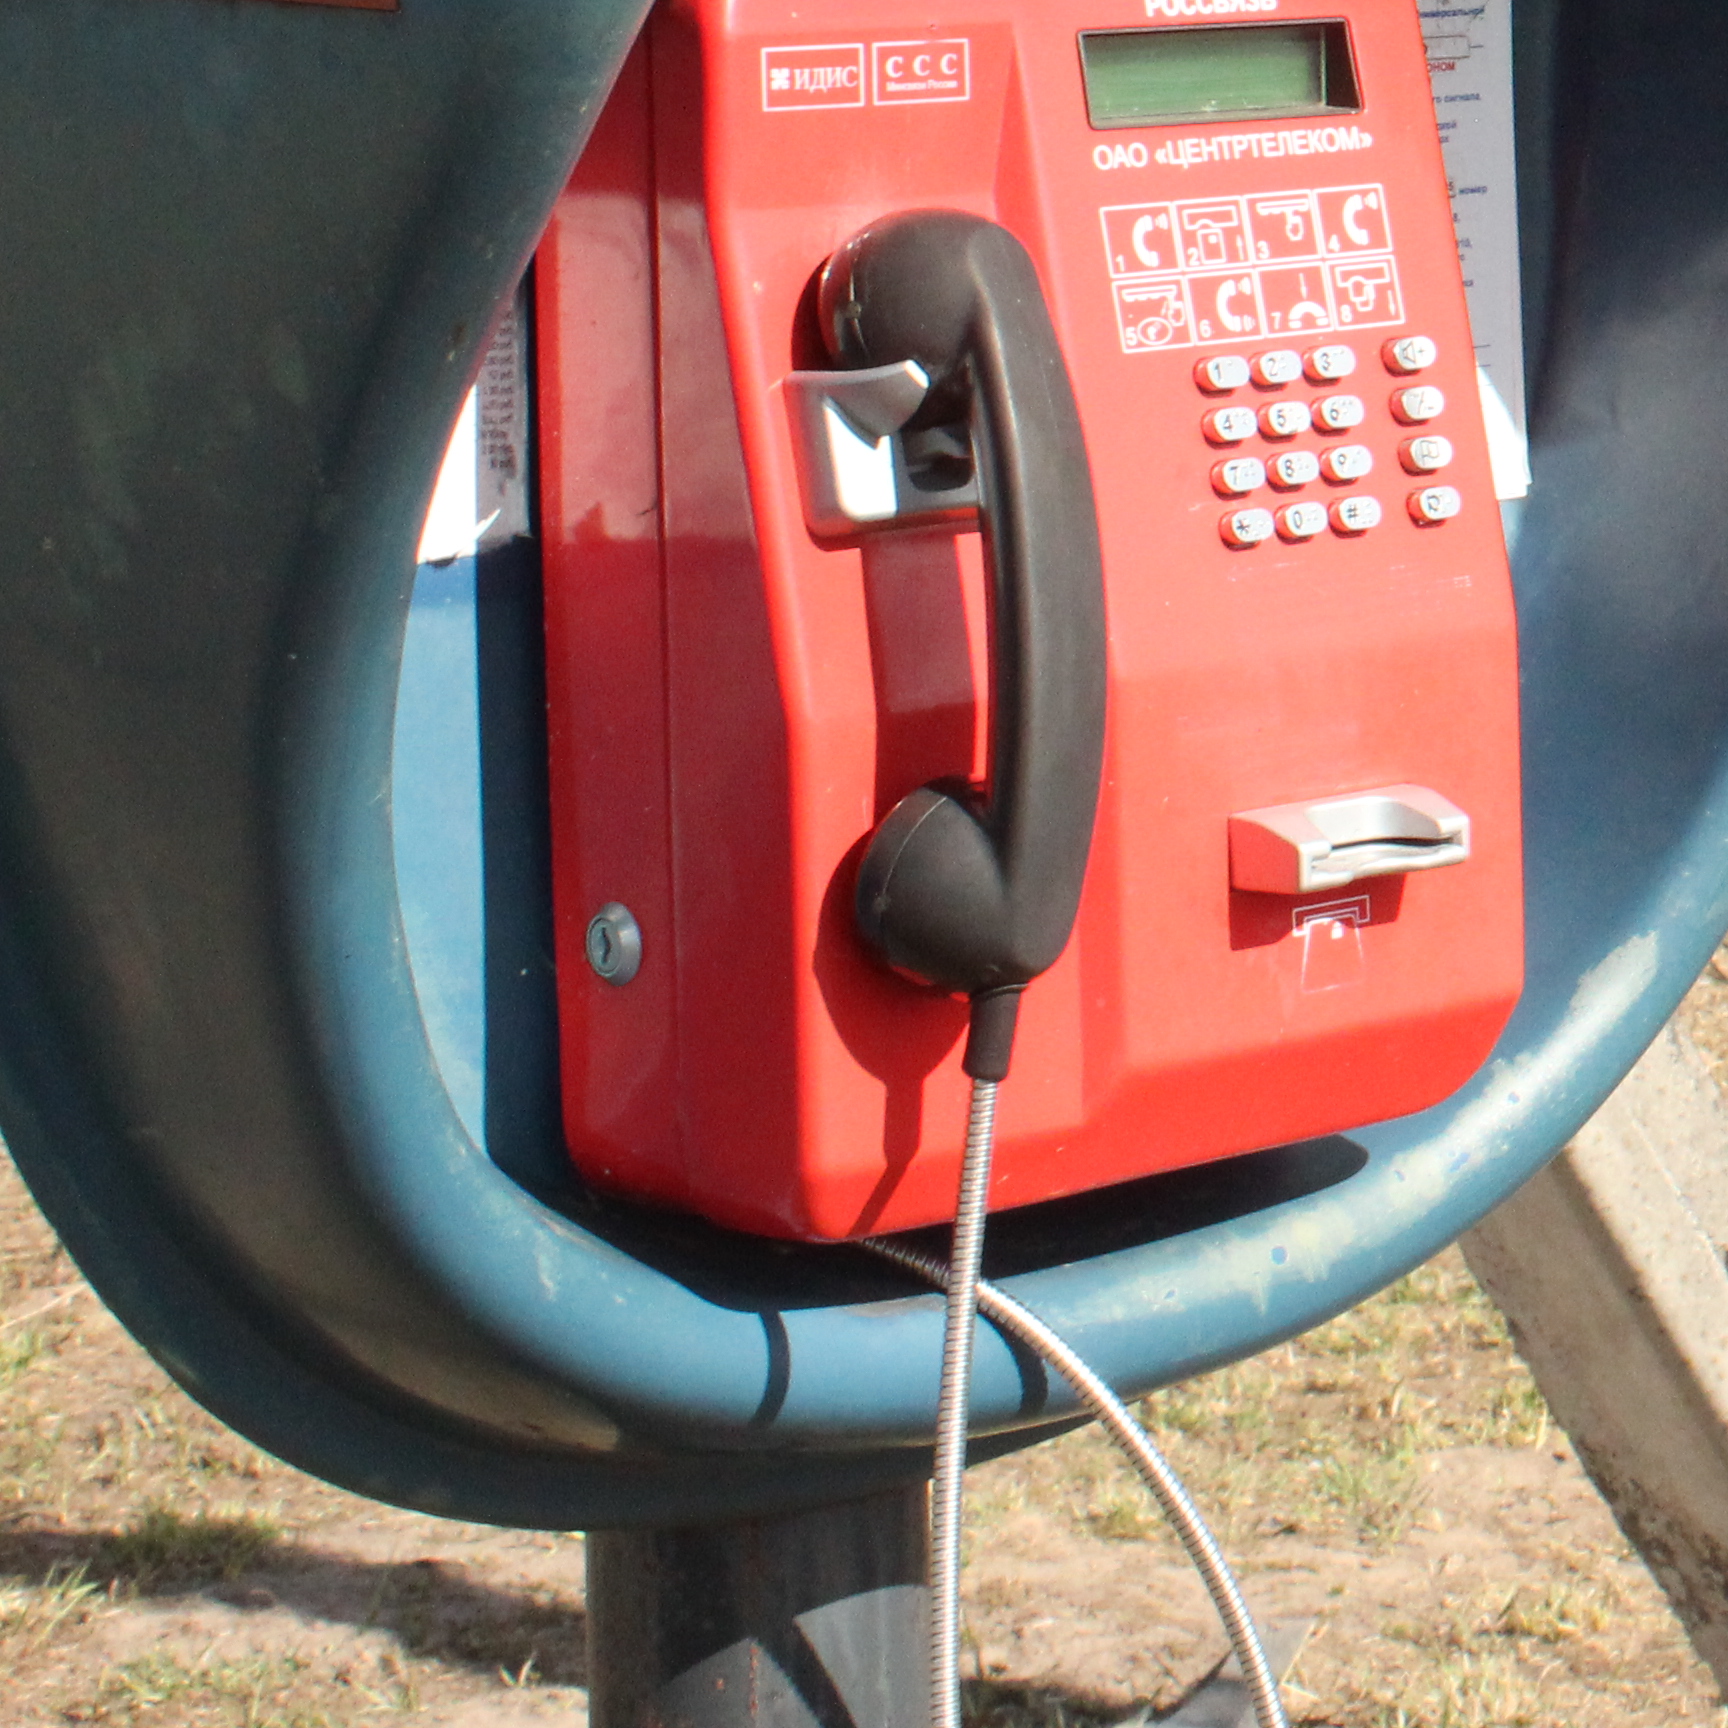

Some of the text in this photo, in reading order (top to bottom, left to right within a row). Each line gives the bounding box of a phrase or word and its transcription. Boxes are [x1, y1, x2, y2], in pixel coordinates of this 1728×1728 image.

[794, 65, 859, 94] ИДИС
[1093, 126, 1373, 171] ОАО «ЦЕНТРТЕЛЕКОМ»
[1257, 240, 1270, 259] 3
[1328, 234, 1340, 253] 4
[1115, 254, 1125, 272] 1
[1187, 246, 1200, 266] 2
[1271, 311, 1282, 330] 7
[1340, 304, 1353, 323] 8
[1125, 326, 1138, 346] 5
[1199, 319, 1212, 338] 6
